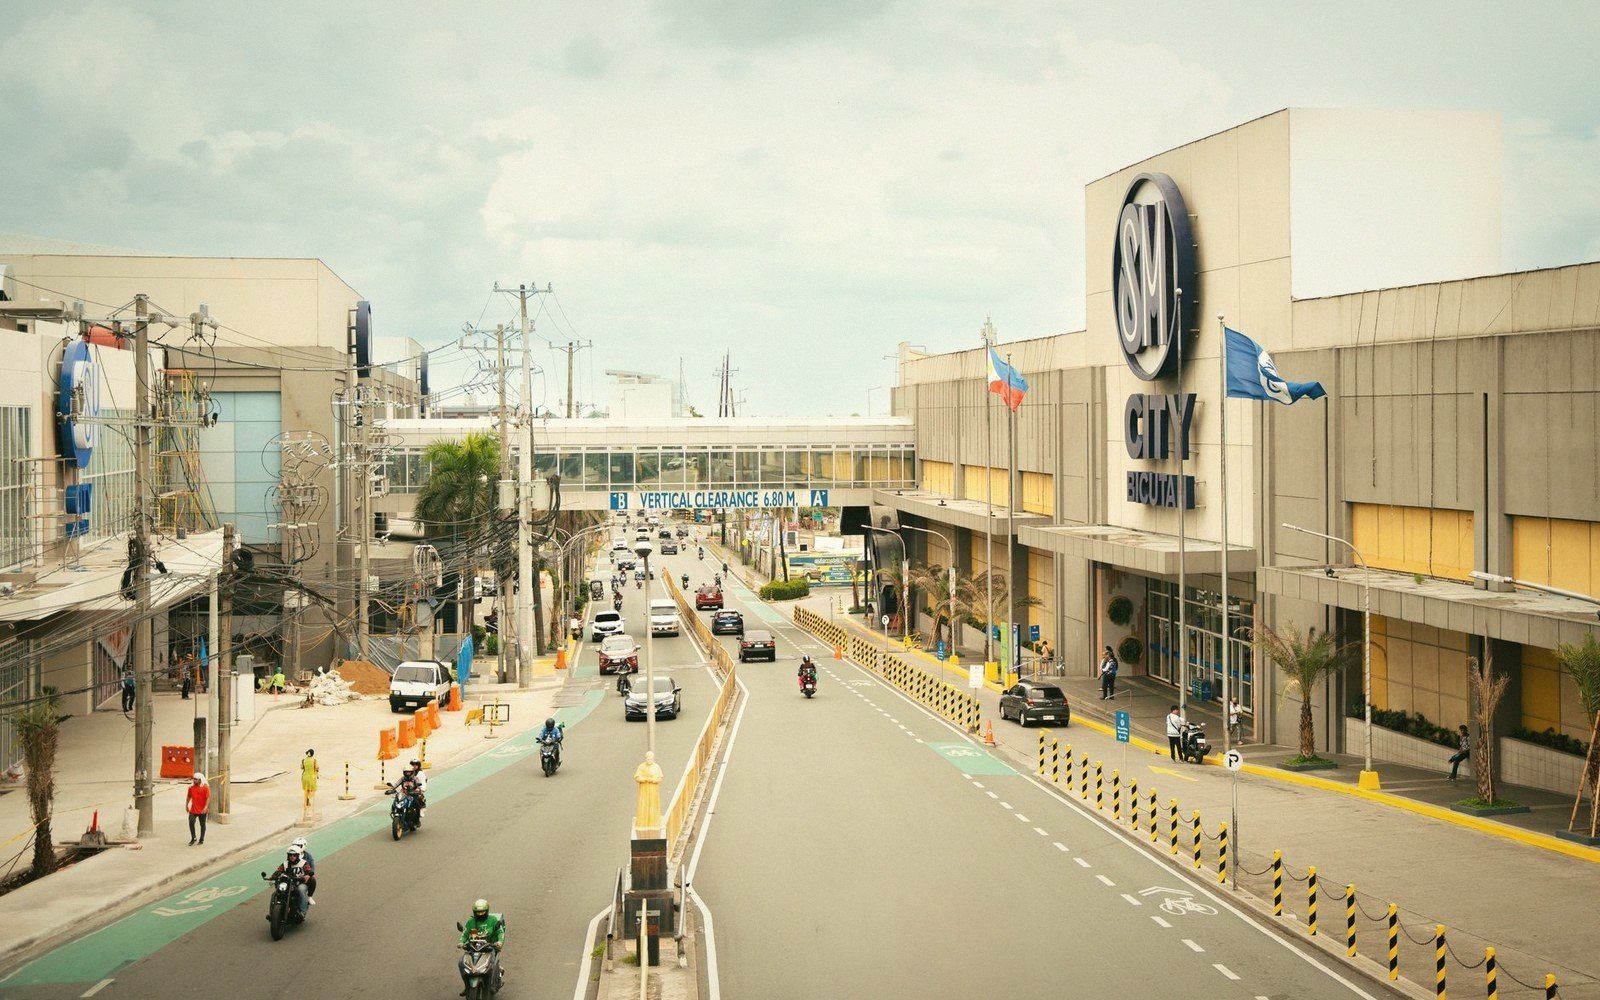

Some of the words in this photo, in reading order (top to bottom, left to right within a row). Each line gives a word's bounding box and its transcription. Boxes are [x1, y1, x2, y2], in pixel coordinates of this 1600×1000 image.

[1118, 201, 1168, 354] SM
[1125, 393, 1196, 460] CITY
[618, 493, 625, 508] B
[640, 492, 692, 508] VERTICAL
[695, 492, 758, 508] CLEARANCE
[764, 491, 783, 507] 6.80
[787, 491, 799, 507] M.
[812, 490, 824, 507] A
